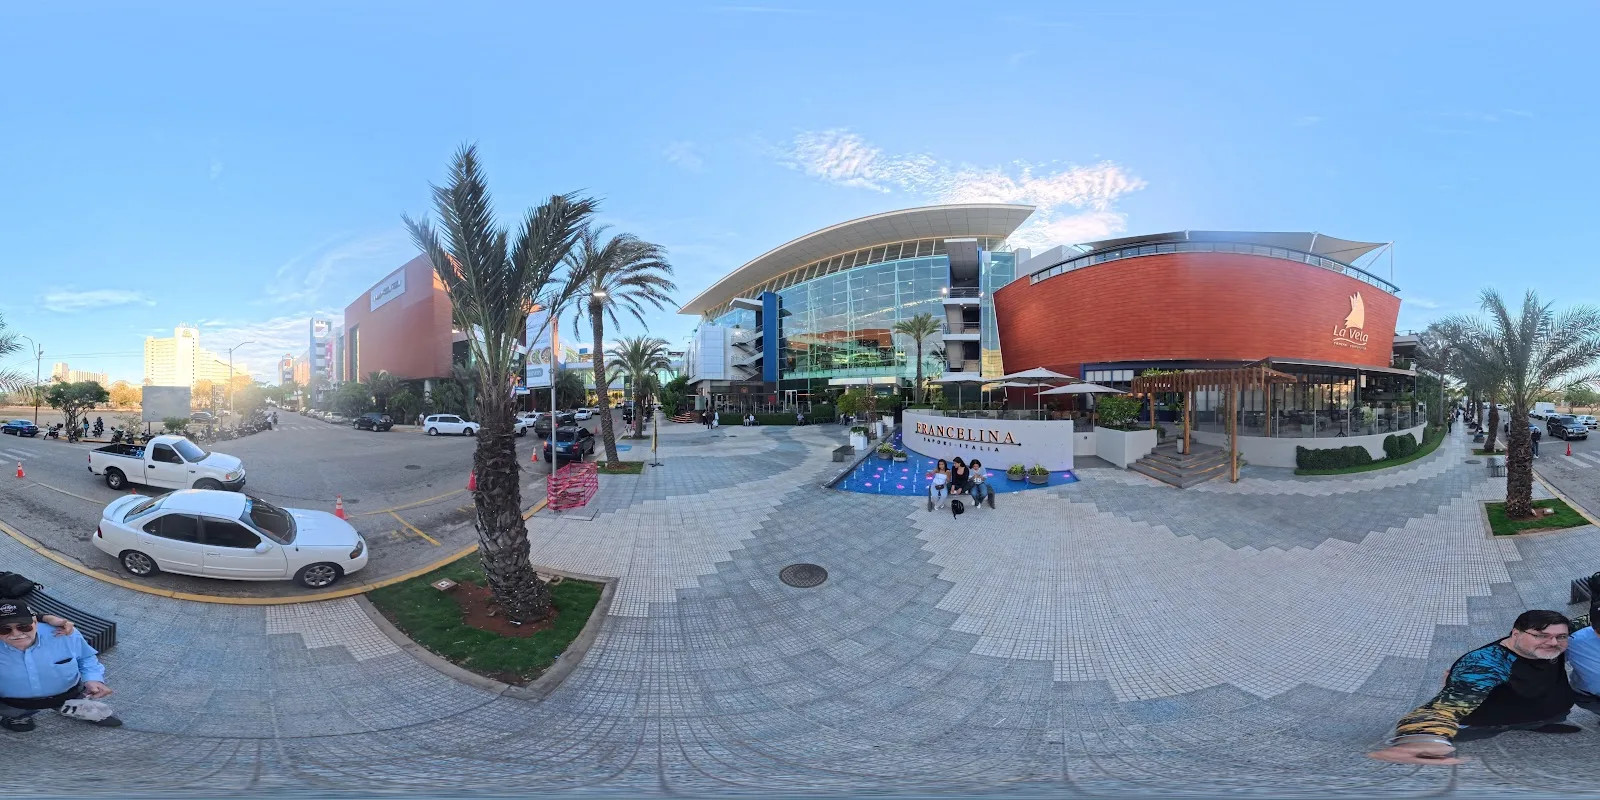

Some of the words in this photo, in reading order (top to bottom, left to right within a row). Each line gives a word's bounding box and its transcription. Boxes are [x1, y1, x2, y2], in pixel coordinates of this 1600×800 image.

[1333, 324, 1346, 337] La
[1349, 328, 1369, 342] Vela
[916, 422, 1016, 444] FRANCELINA
